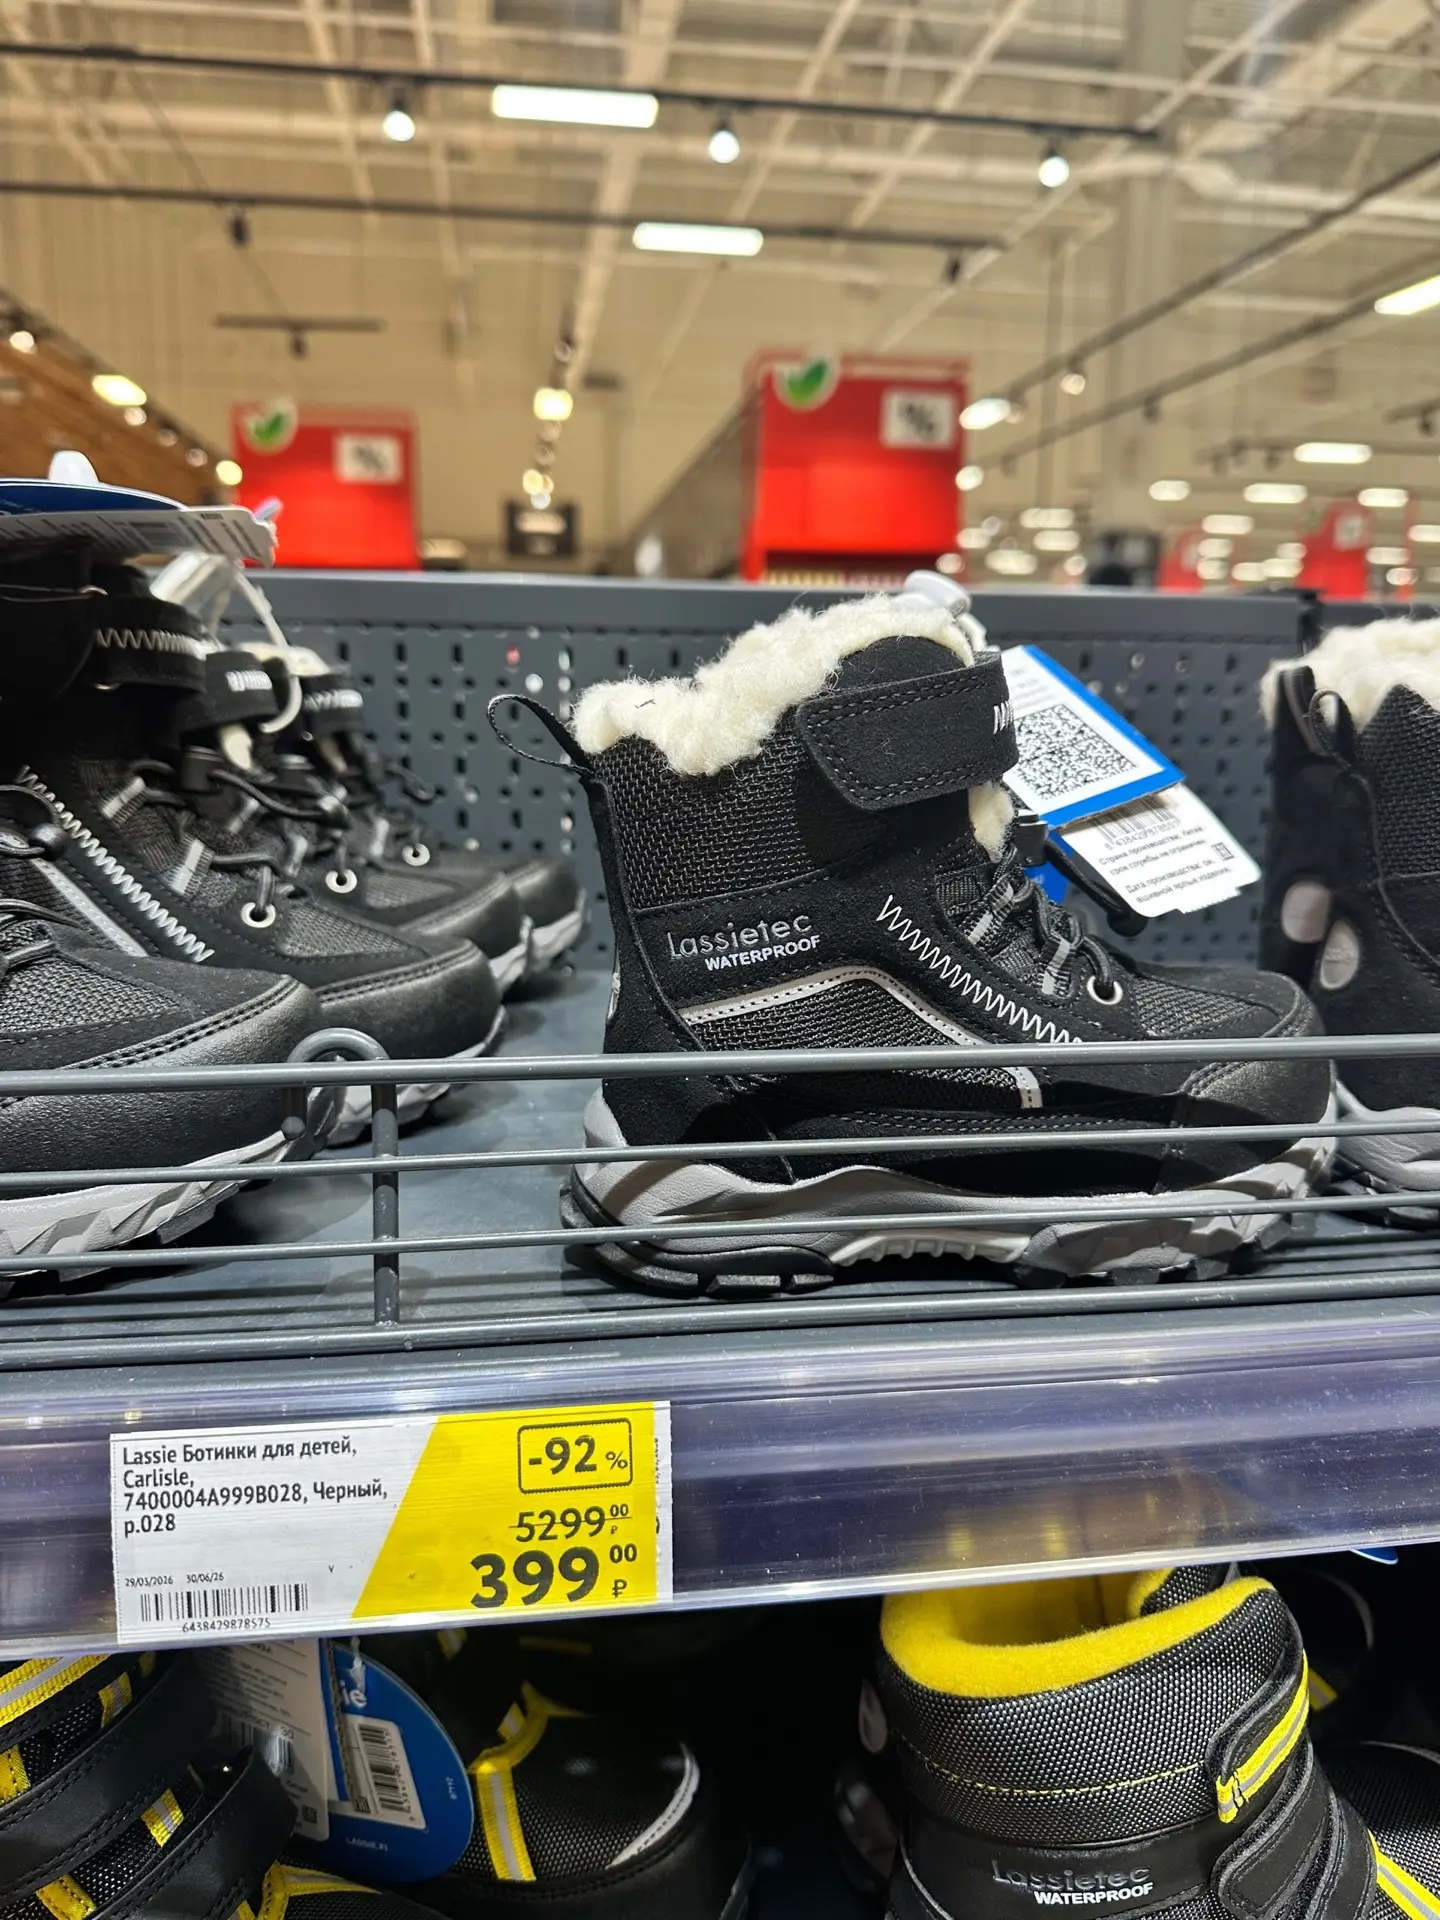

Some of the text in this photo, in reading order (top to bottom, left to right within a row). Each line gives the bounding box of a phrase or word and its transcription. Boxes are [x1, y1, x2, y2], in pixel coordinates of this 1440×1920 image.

[1125, 882, 1146, 893] Дата
[667, 915, 812, 960] Lassietec
[705, 935, 820, 971] WATERPROOF
[123, 1435, 357, 1465] Lassie Ботинки для детей,
[528, 1434, 597, 1475] -92
[605, 1450, 628, 1469] %
[123, 1467, 194, 1488] Carlisle,
[124, 1478, 387, 1512] 7400004A999B028, Черный,
[124, 1513, 176, 1538] р.028
[516, 1503, 629, 1542] 5299 00
[125, 1572, 225, 1587] 29/03/2026 30/06/26
[470, 1543, 637, 1609] 399 00
[182, 1617, 271, 1633] 6438429878575
[991, 1859, 1150, 1890] Lassietec
[1034, 1882, 1154, 1904] WATERPROOF
